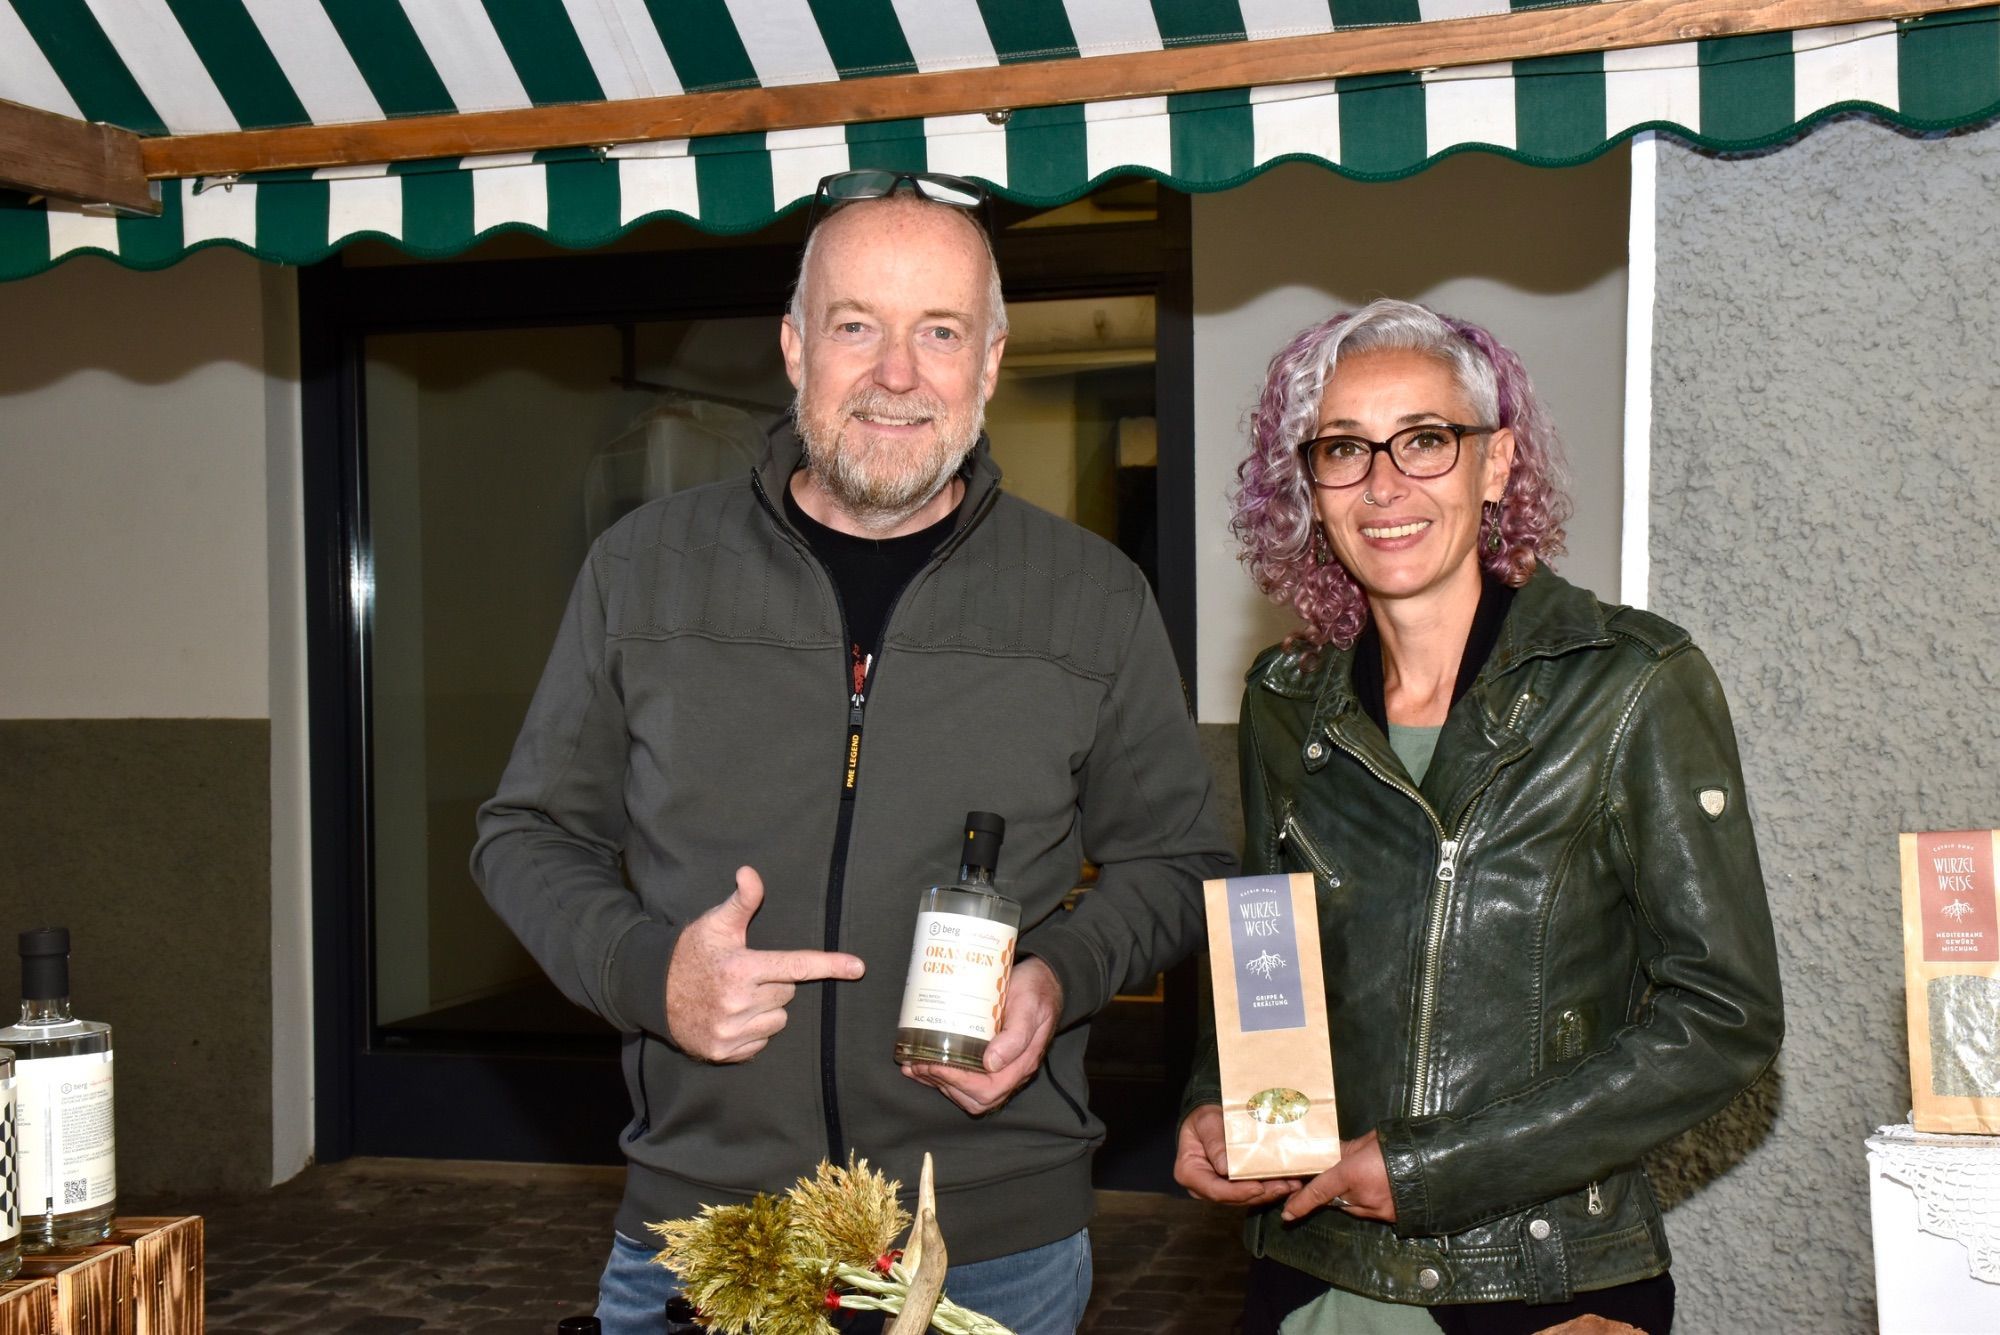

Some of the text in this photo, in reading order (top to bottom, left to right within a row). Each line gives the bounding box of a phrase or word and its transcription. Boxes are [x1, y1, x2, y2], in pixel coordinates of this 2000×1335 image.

[847, 734, 860, 787] PME LEGEND
[1933, 857, 1976, 874] WURZEL
[1938, 875, 1974, 891] WEISE
[1240, 900, 1281, 919] WURZEL
[942, 924, 961, 937] berg
[1245, 919, 1280, 937] WEISE
[926, 945, 994, 967] ORAGEN
